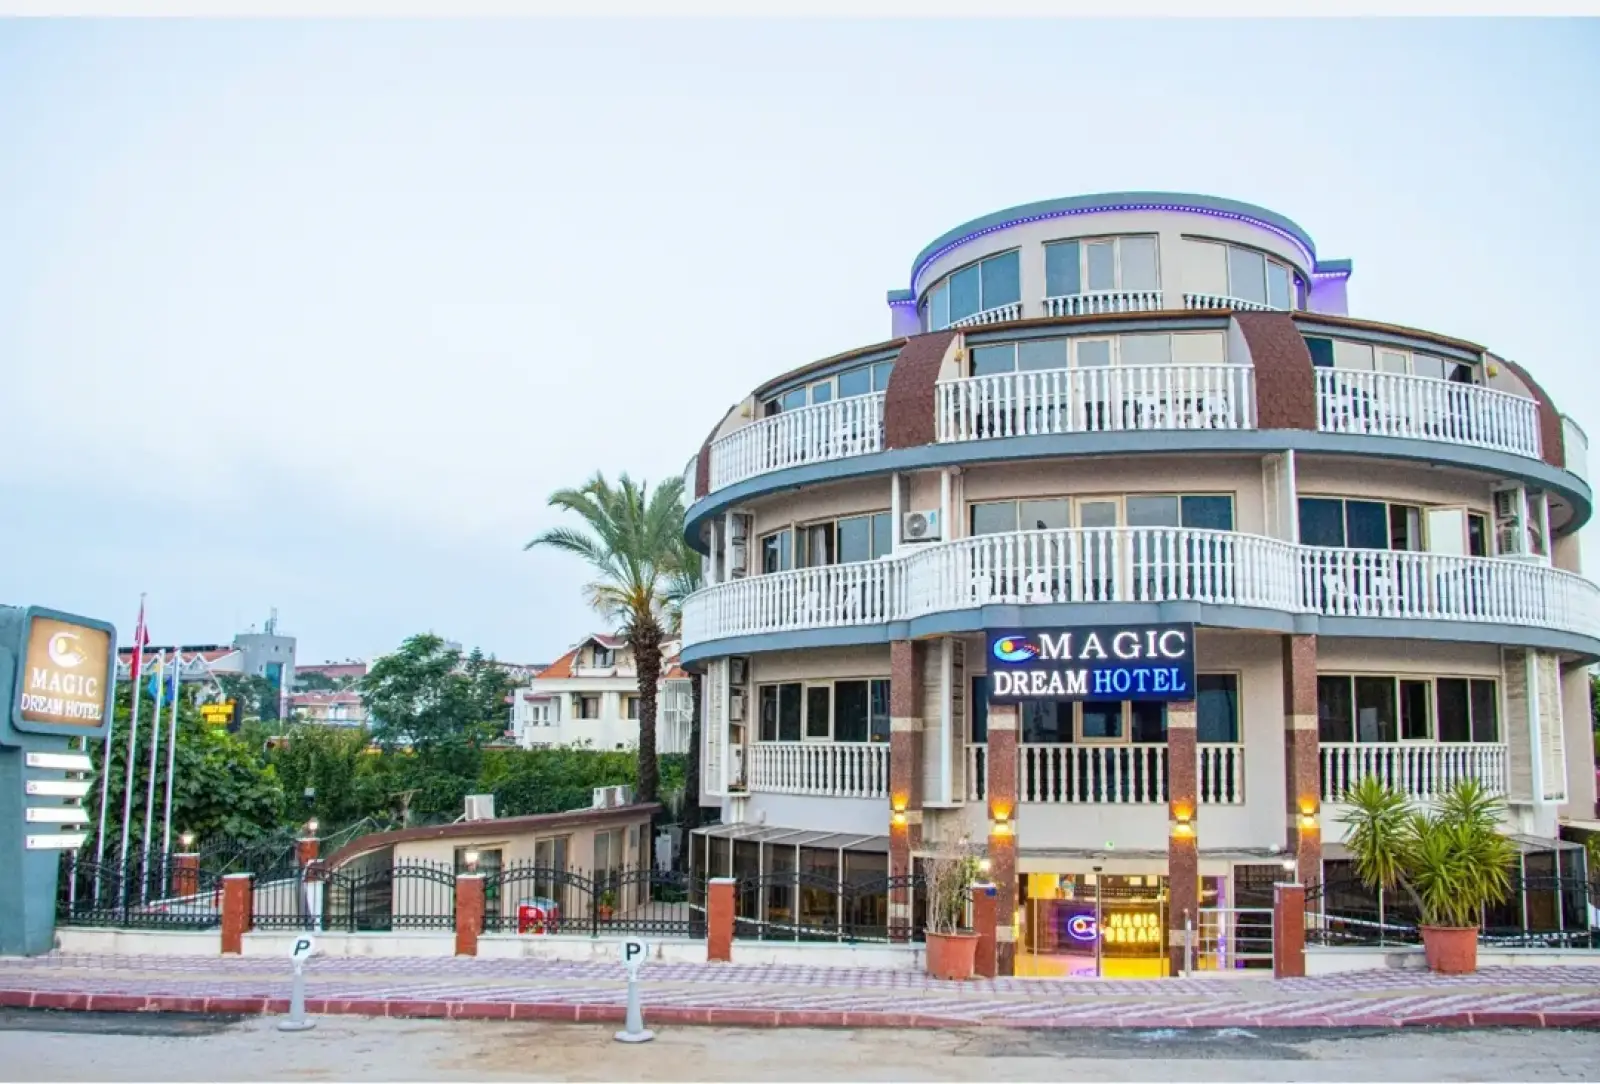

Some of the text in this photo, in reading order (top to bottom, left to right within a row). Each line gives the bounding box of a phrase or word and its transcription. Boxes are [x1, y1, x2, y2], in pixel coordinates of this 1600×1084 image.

[1038, 630, 1187, 660] MAGIC
[31, 667, 97, 697] MAGIC
[993, 667, 1187, 696] DREAM HOTEL
[21, 693, 102, 719] DREAM HOTEL
[1110, 913, 1158, 928] MAGIC
[1105, 926, 1161, 943] DREAM
[293, 939, 310, 956] P
[626, 942, 641, 961] P
